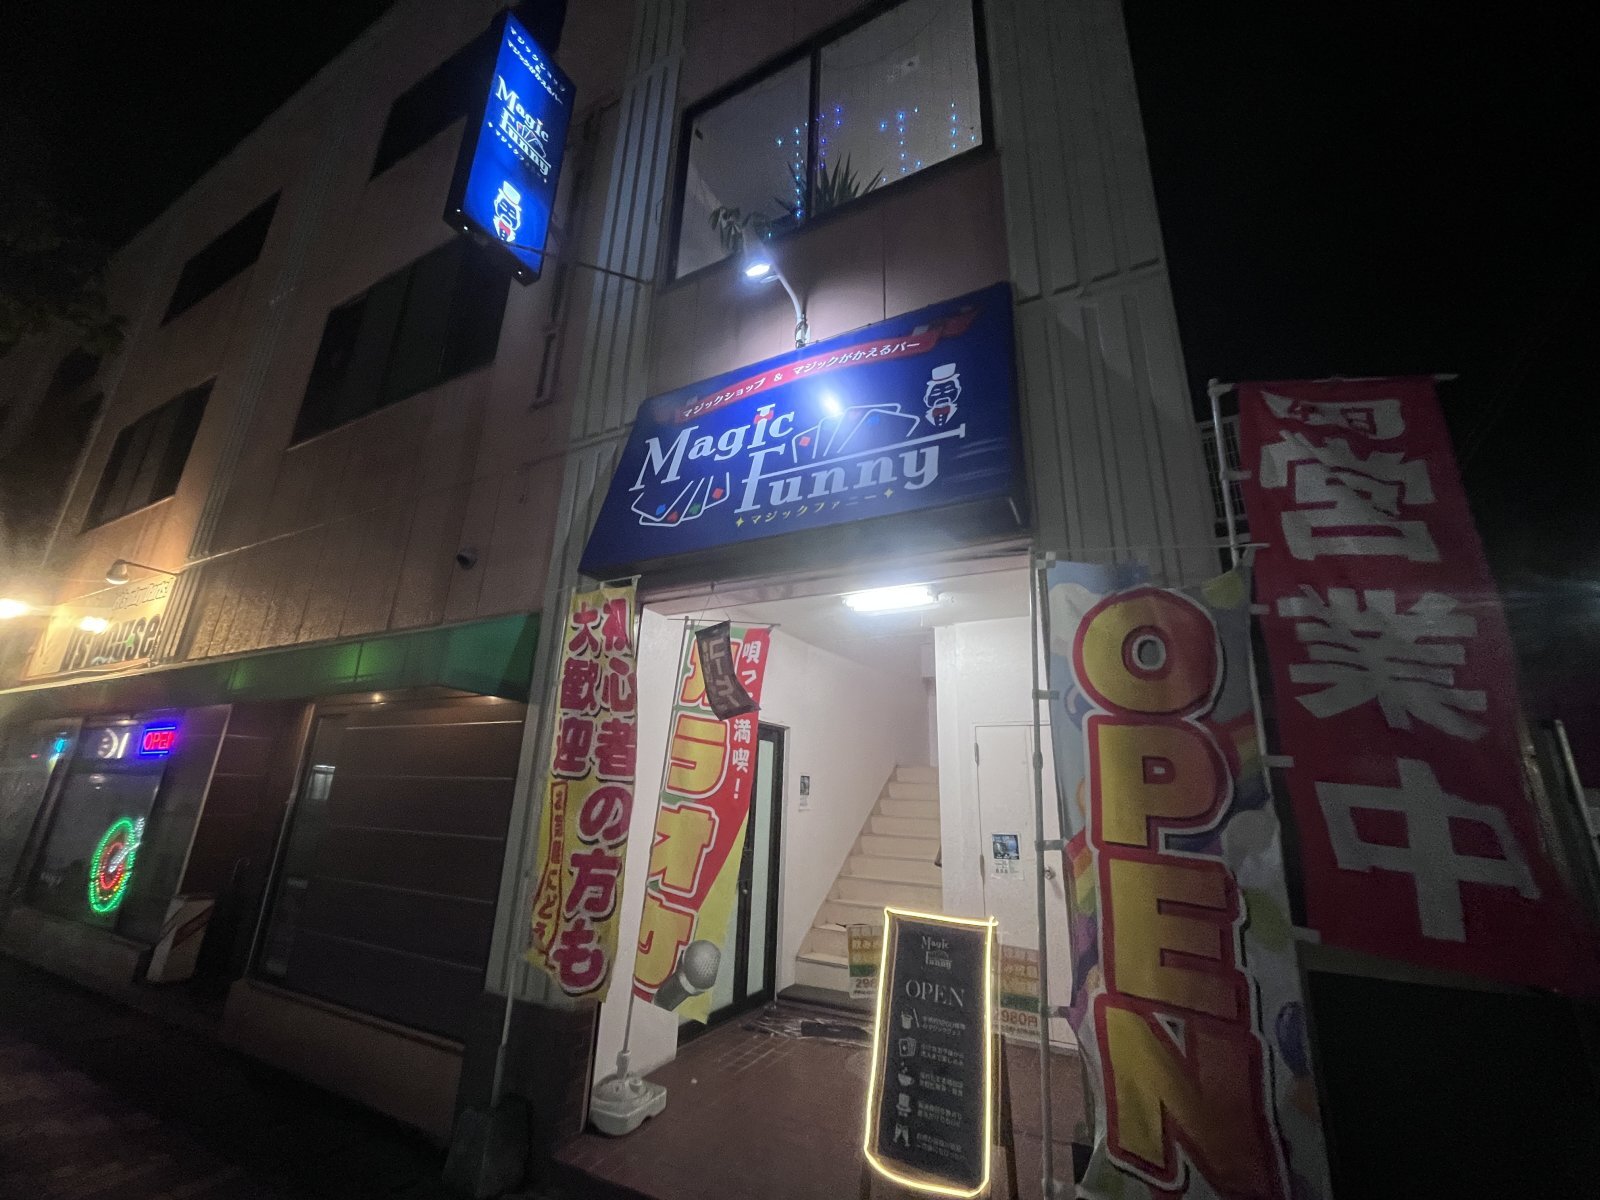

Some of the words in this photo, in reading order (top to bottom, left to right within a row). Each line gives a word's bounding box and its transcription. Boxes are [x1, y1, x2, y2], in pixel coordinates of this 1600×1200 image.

[495, 74, 549, 143] Magic
[498, 106, 551, 177] Funny
[683, 377, 767, 418] マジックショップ
[773, 373, 783, 382] &
[793, 341, 920, 376] マジックがかえるバー
[628, 403, 795, 492] Magic
[734, 424, 966, 514] Funny
[551, 601, 599, 776] 大歓迎
[1072, 585, 1287, 1200] OPEN
[920, 935, 950, 951] Magic
[905, 978, 965, 1008] OPEN
